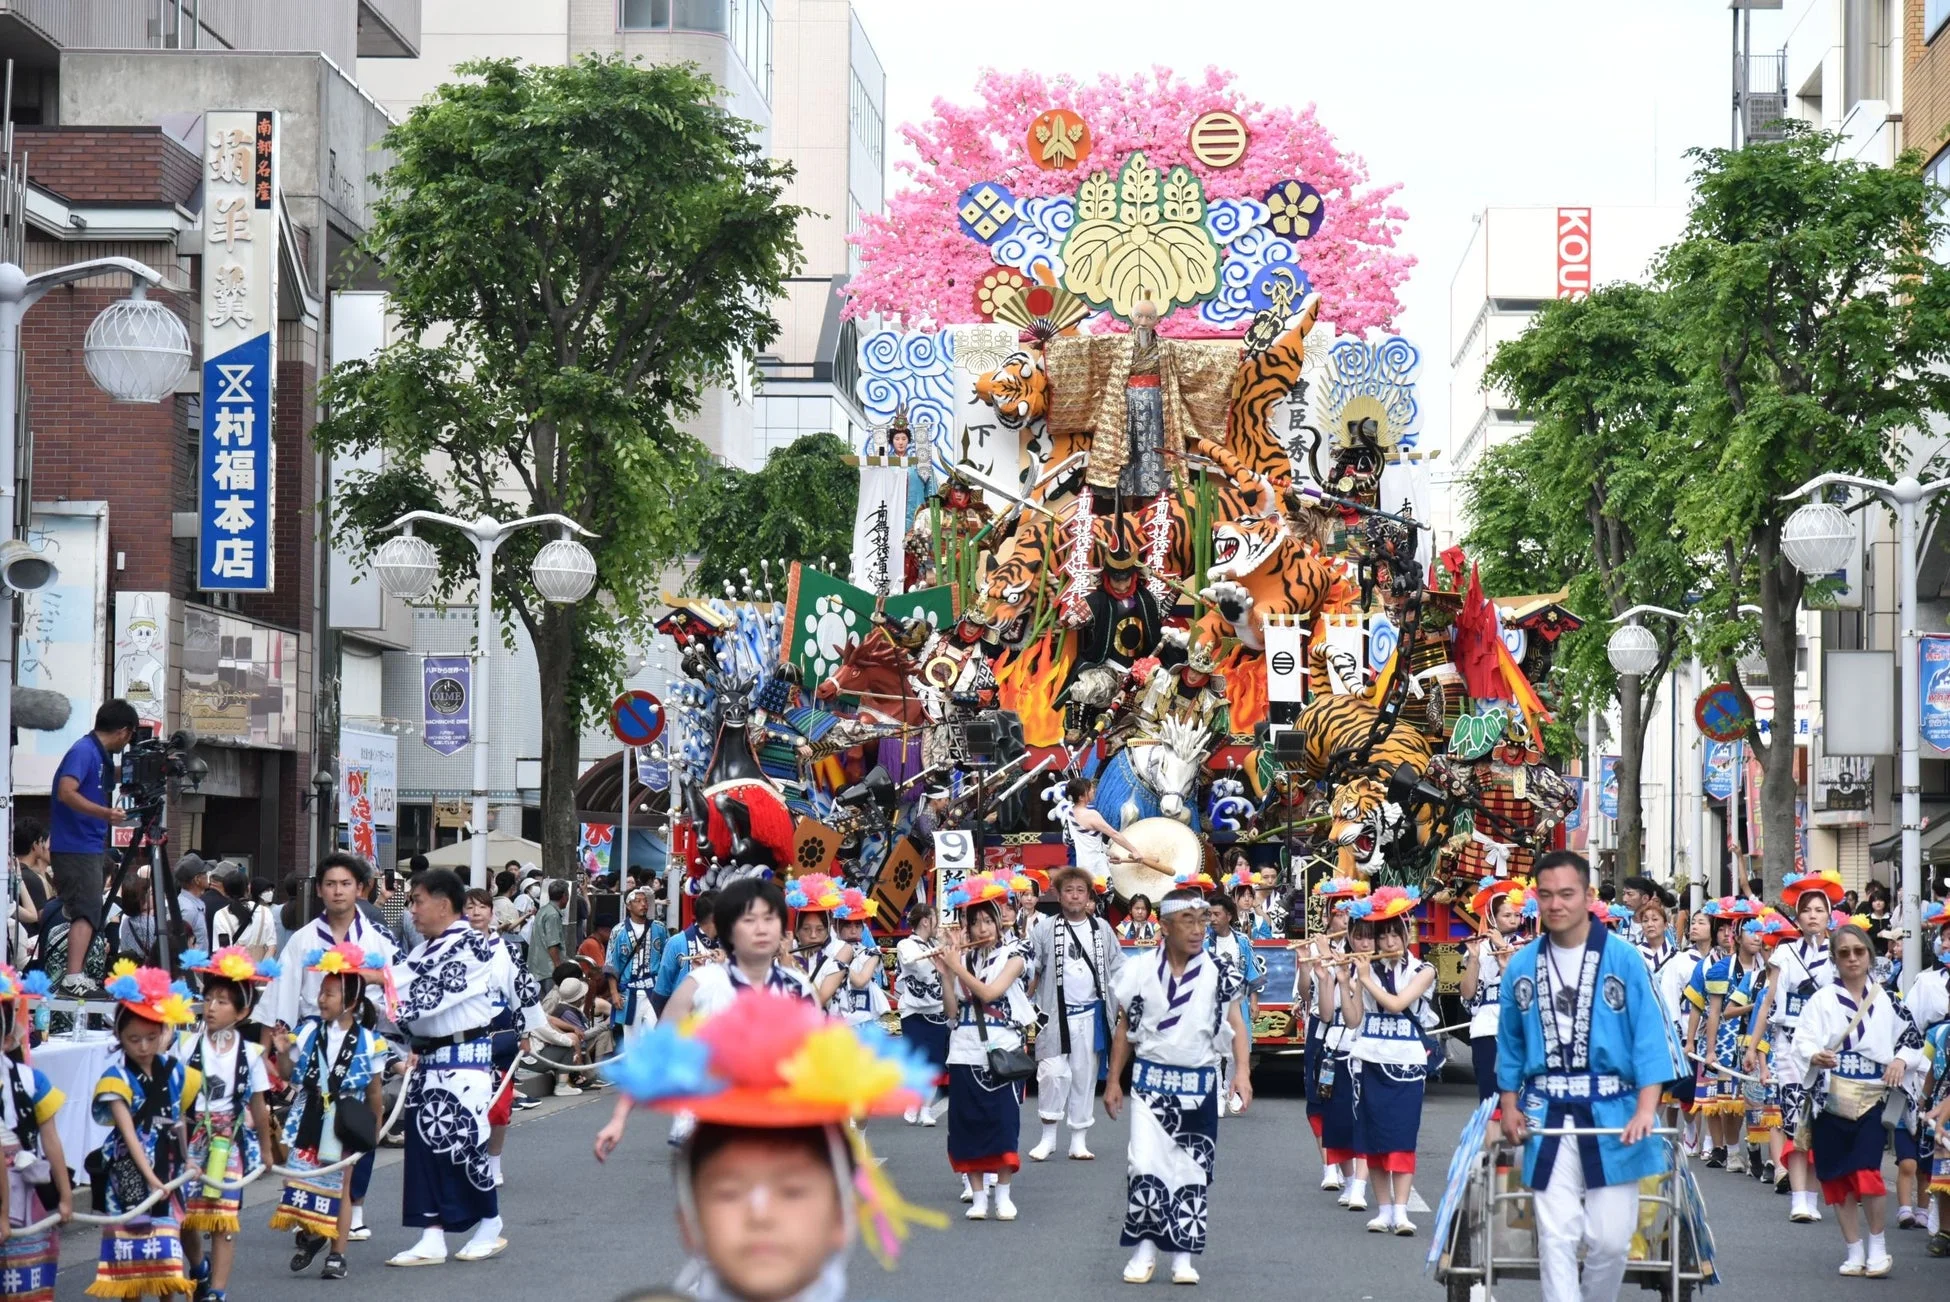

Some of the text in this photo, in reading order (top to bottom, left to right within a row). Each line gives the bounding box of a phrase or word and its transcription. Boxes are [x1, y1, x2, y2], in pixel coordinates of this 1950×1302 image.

[211, 406, 255, 578] 村福本店
[432, 692, 461, 701] DIME
[940, 832, 968, 862] 9
[1367, 1016, 1411, 1038] 新井田
[1145, 1066, 1199, 1093] 新井田
[280, 1189, 332, 1215] 井田
[114, 1239, 183, 1261] 新井田
